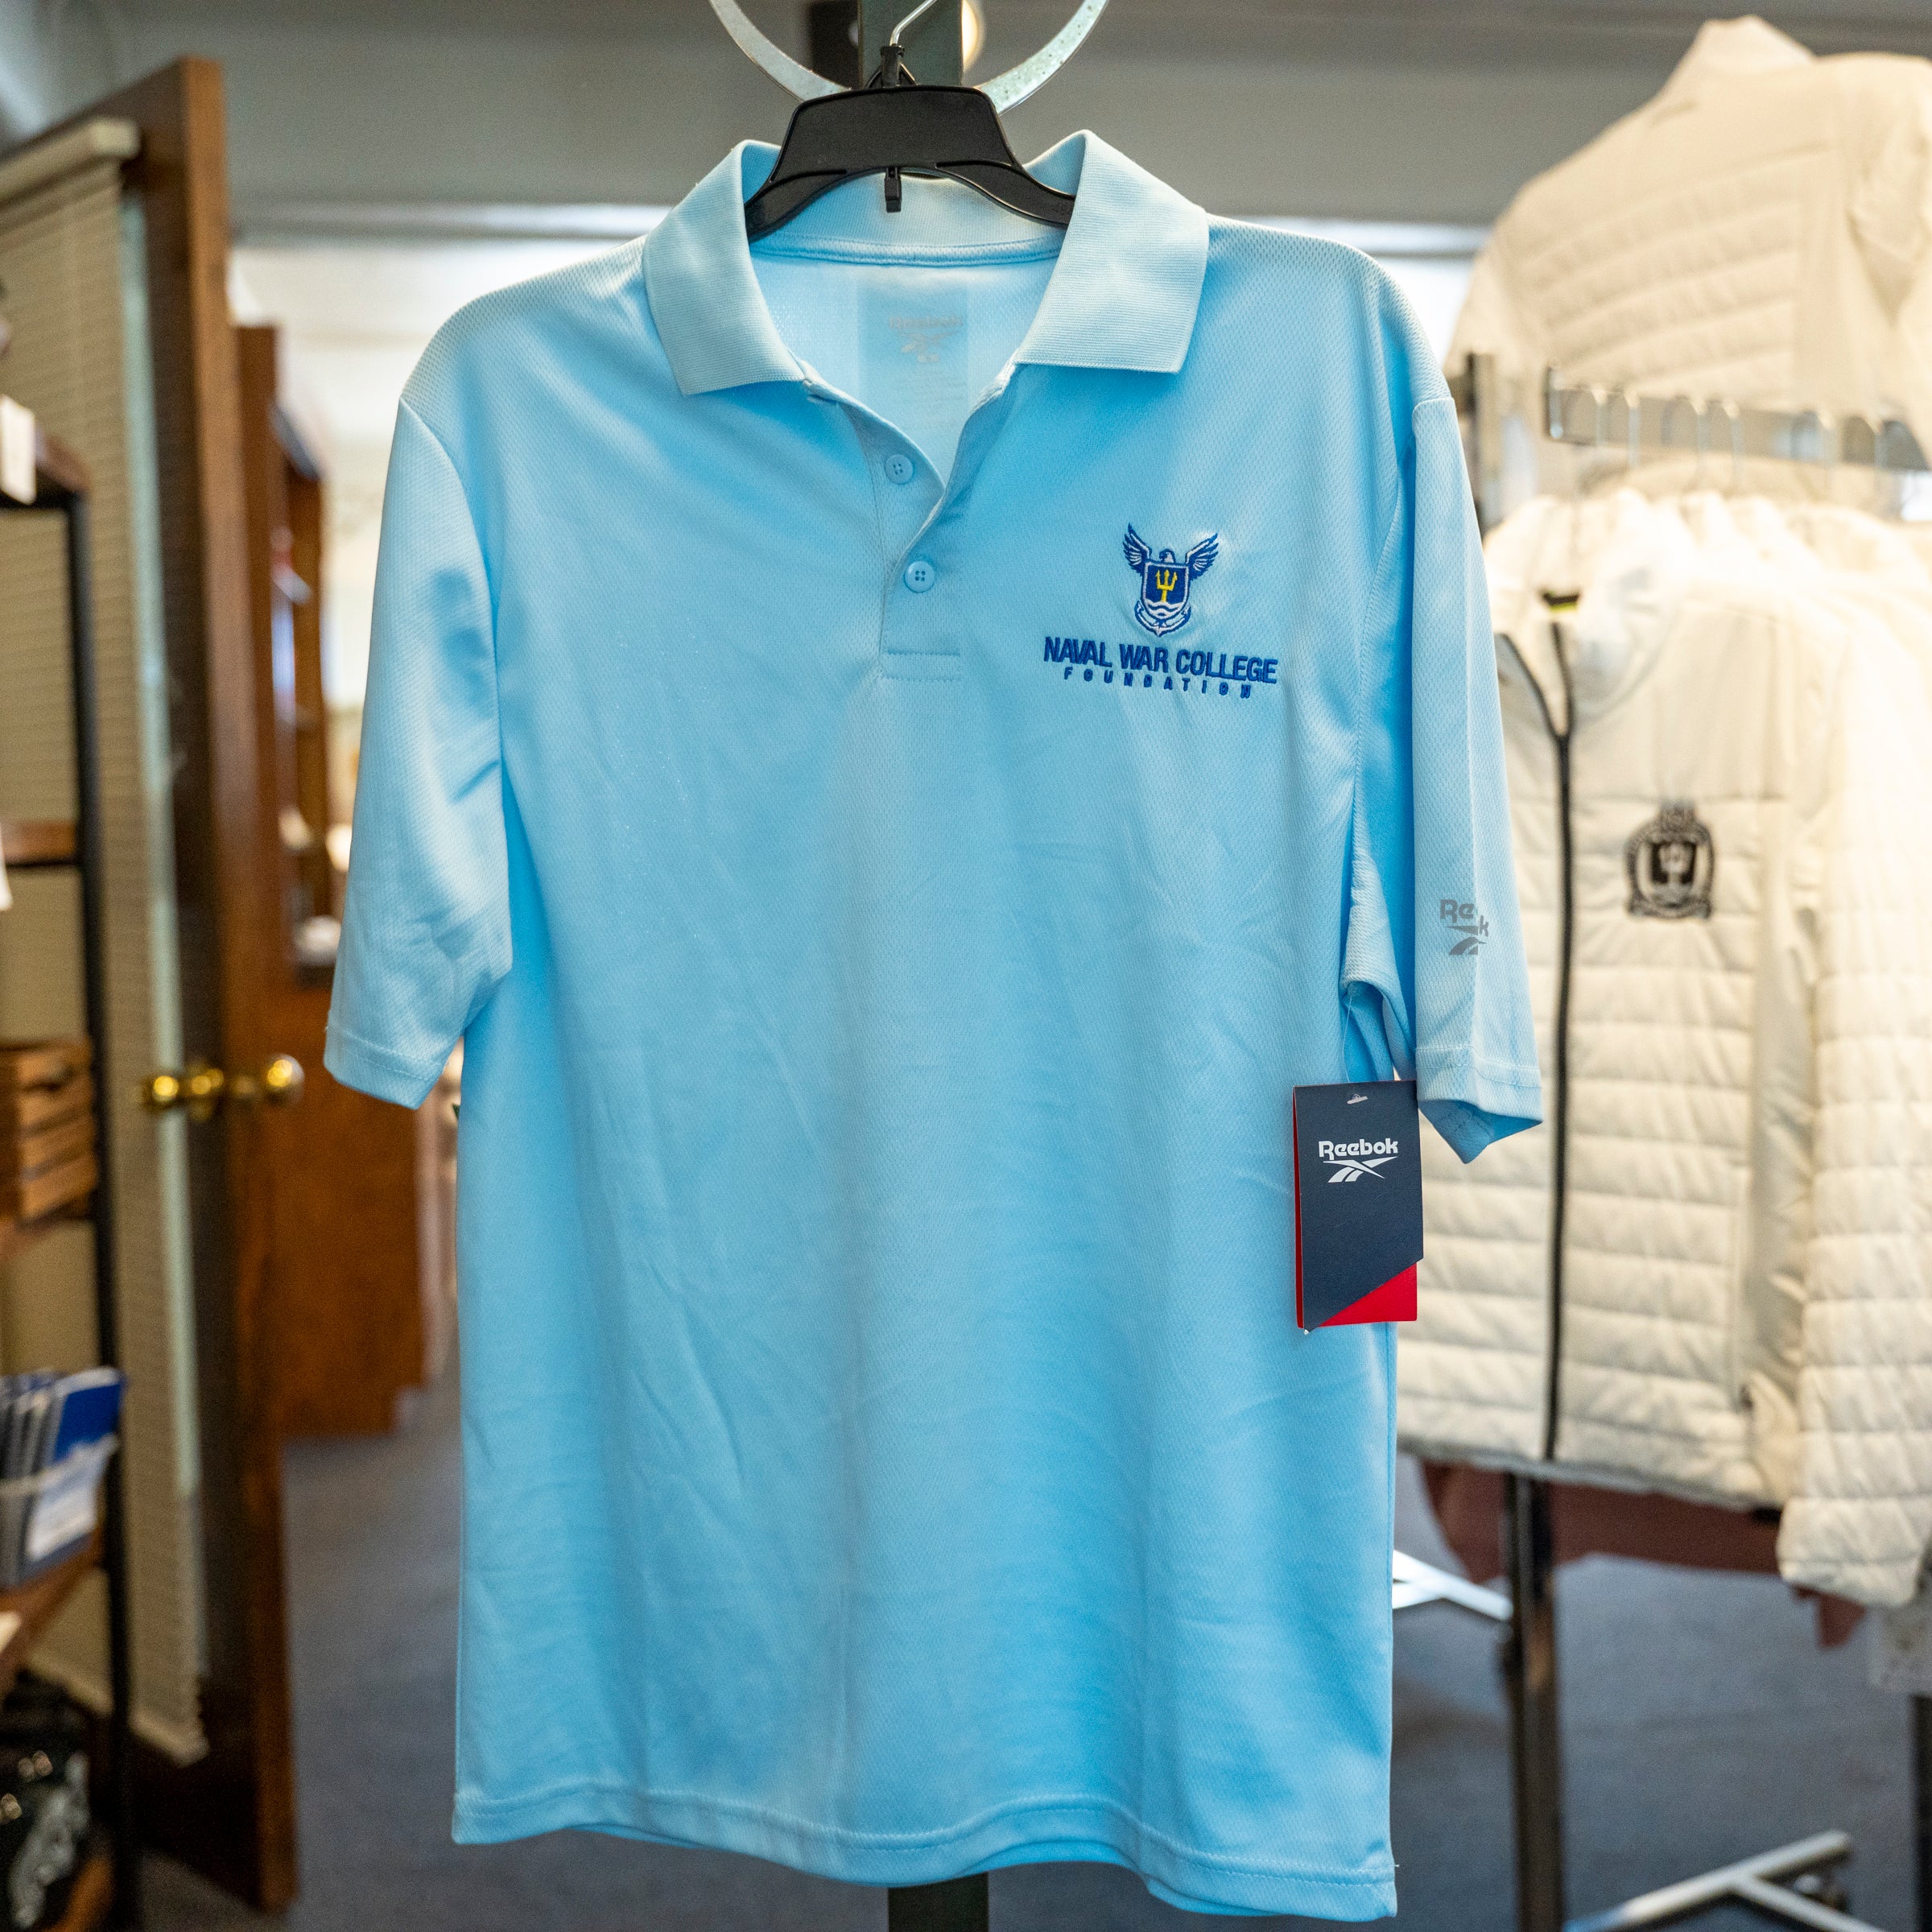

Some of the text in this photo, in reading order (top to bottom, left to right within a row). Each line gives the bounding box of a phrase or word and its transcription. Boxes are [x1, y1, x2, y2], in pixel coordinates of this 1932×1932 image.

[1043, 637, 1278, 683] NAVAL WAR COLLEGE
[1063, 667, 1251, 699] FOUNDATION
[1439, 898, 1488, 937] Rek
[1319, 1137, 1398, 1160] Reebok
